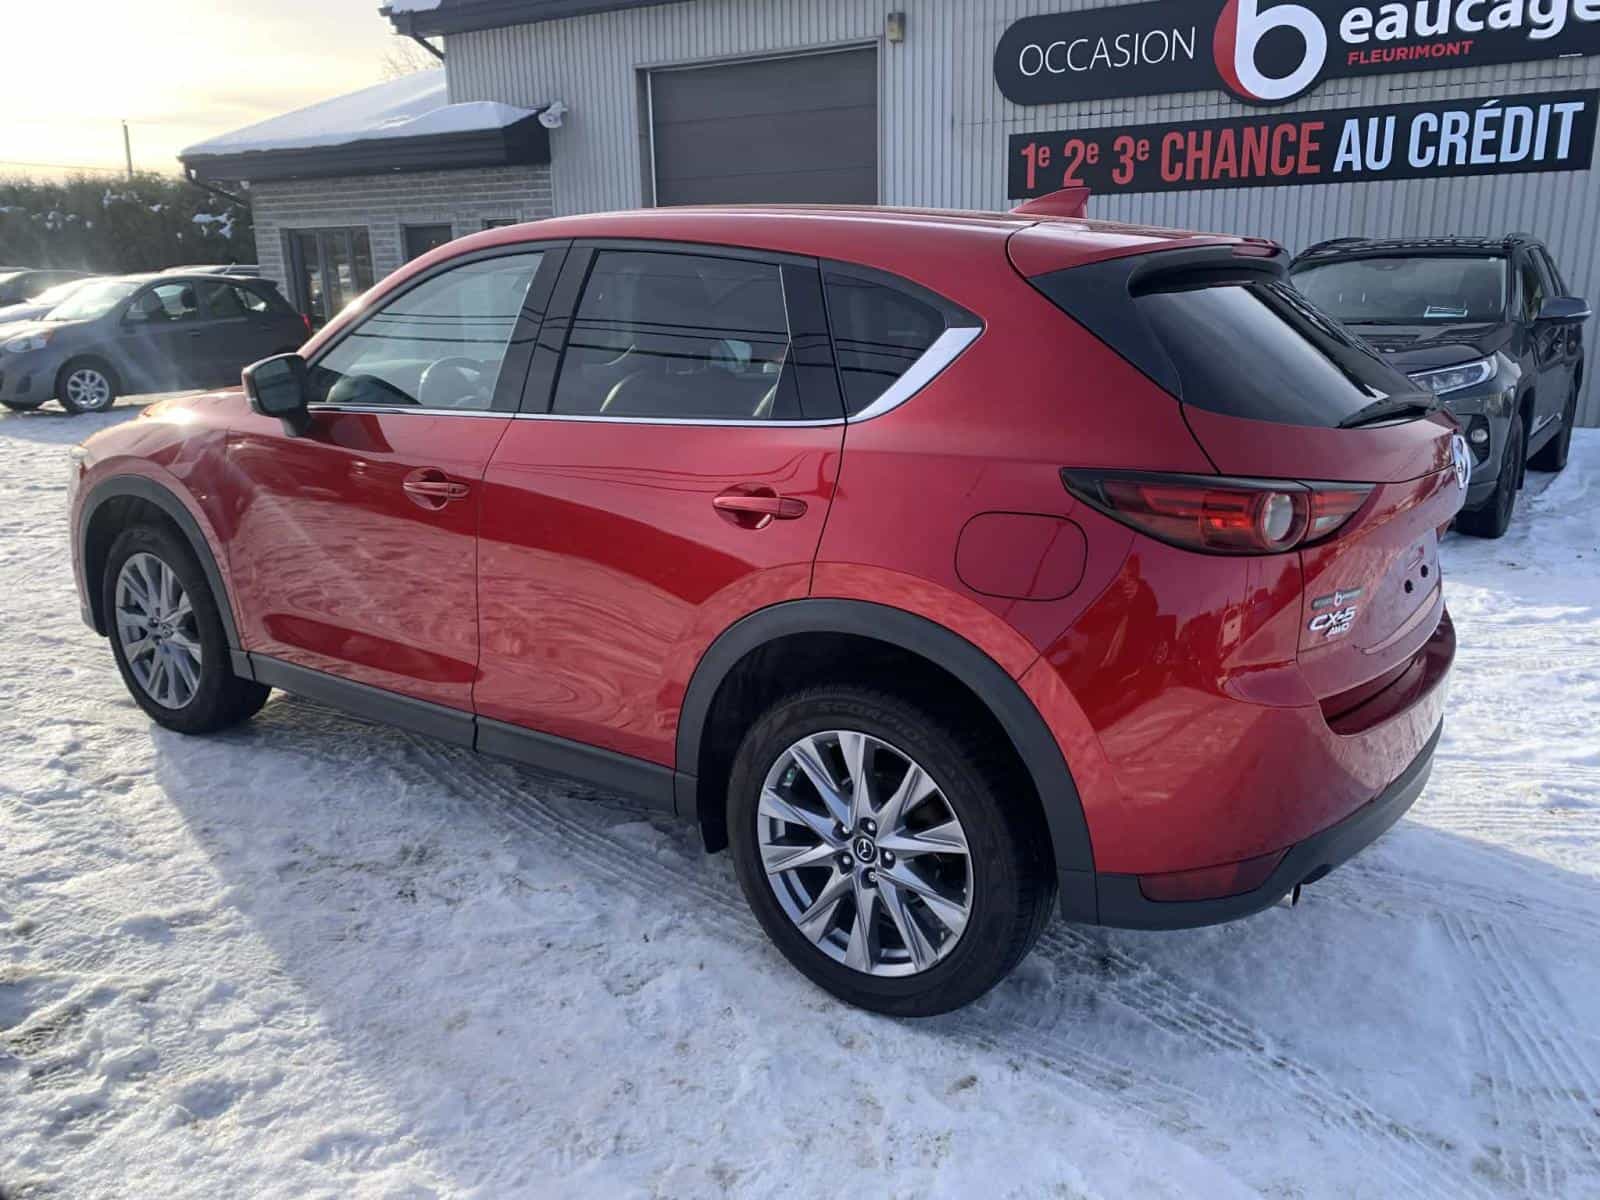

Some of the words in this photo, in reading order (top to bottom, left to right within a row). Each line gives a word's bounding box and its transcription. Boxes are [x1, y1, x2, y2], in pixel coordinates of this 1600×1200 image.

[1018, 26, 1196, 76] OCCASION
[1347, 40, 1474, 65] FLEURIMONT
[1020, 142, 1051, 190] 1e
[1063, 138, 1100, 187] 2e
[1111, 135, 1150, 186] 3e
[1160, 121, 1325, 183] CHANCE
[1332, 115, 1397, 173] AU
[1407, 99, 1585, 168] CRÉDIT
[1310, 605, 1357, 631] CX-5
